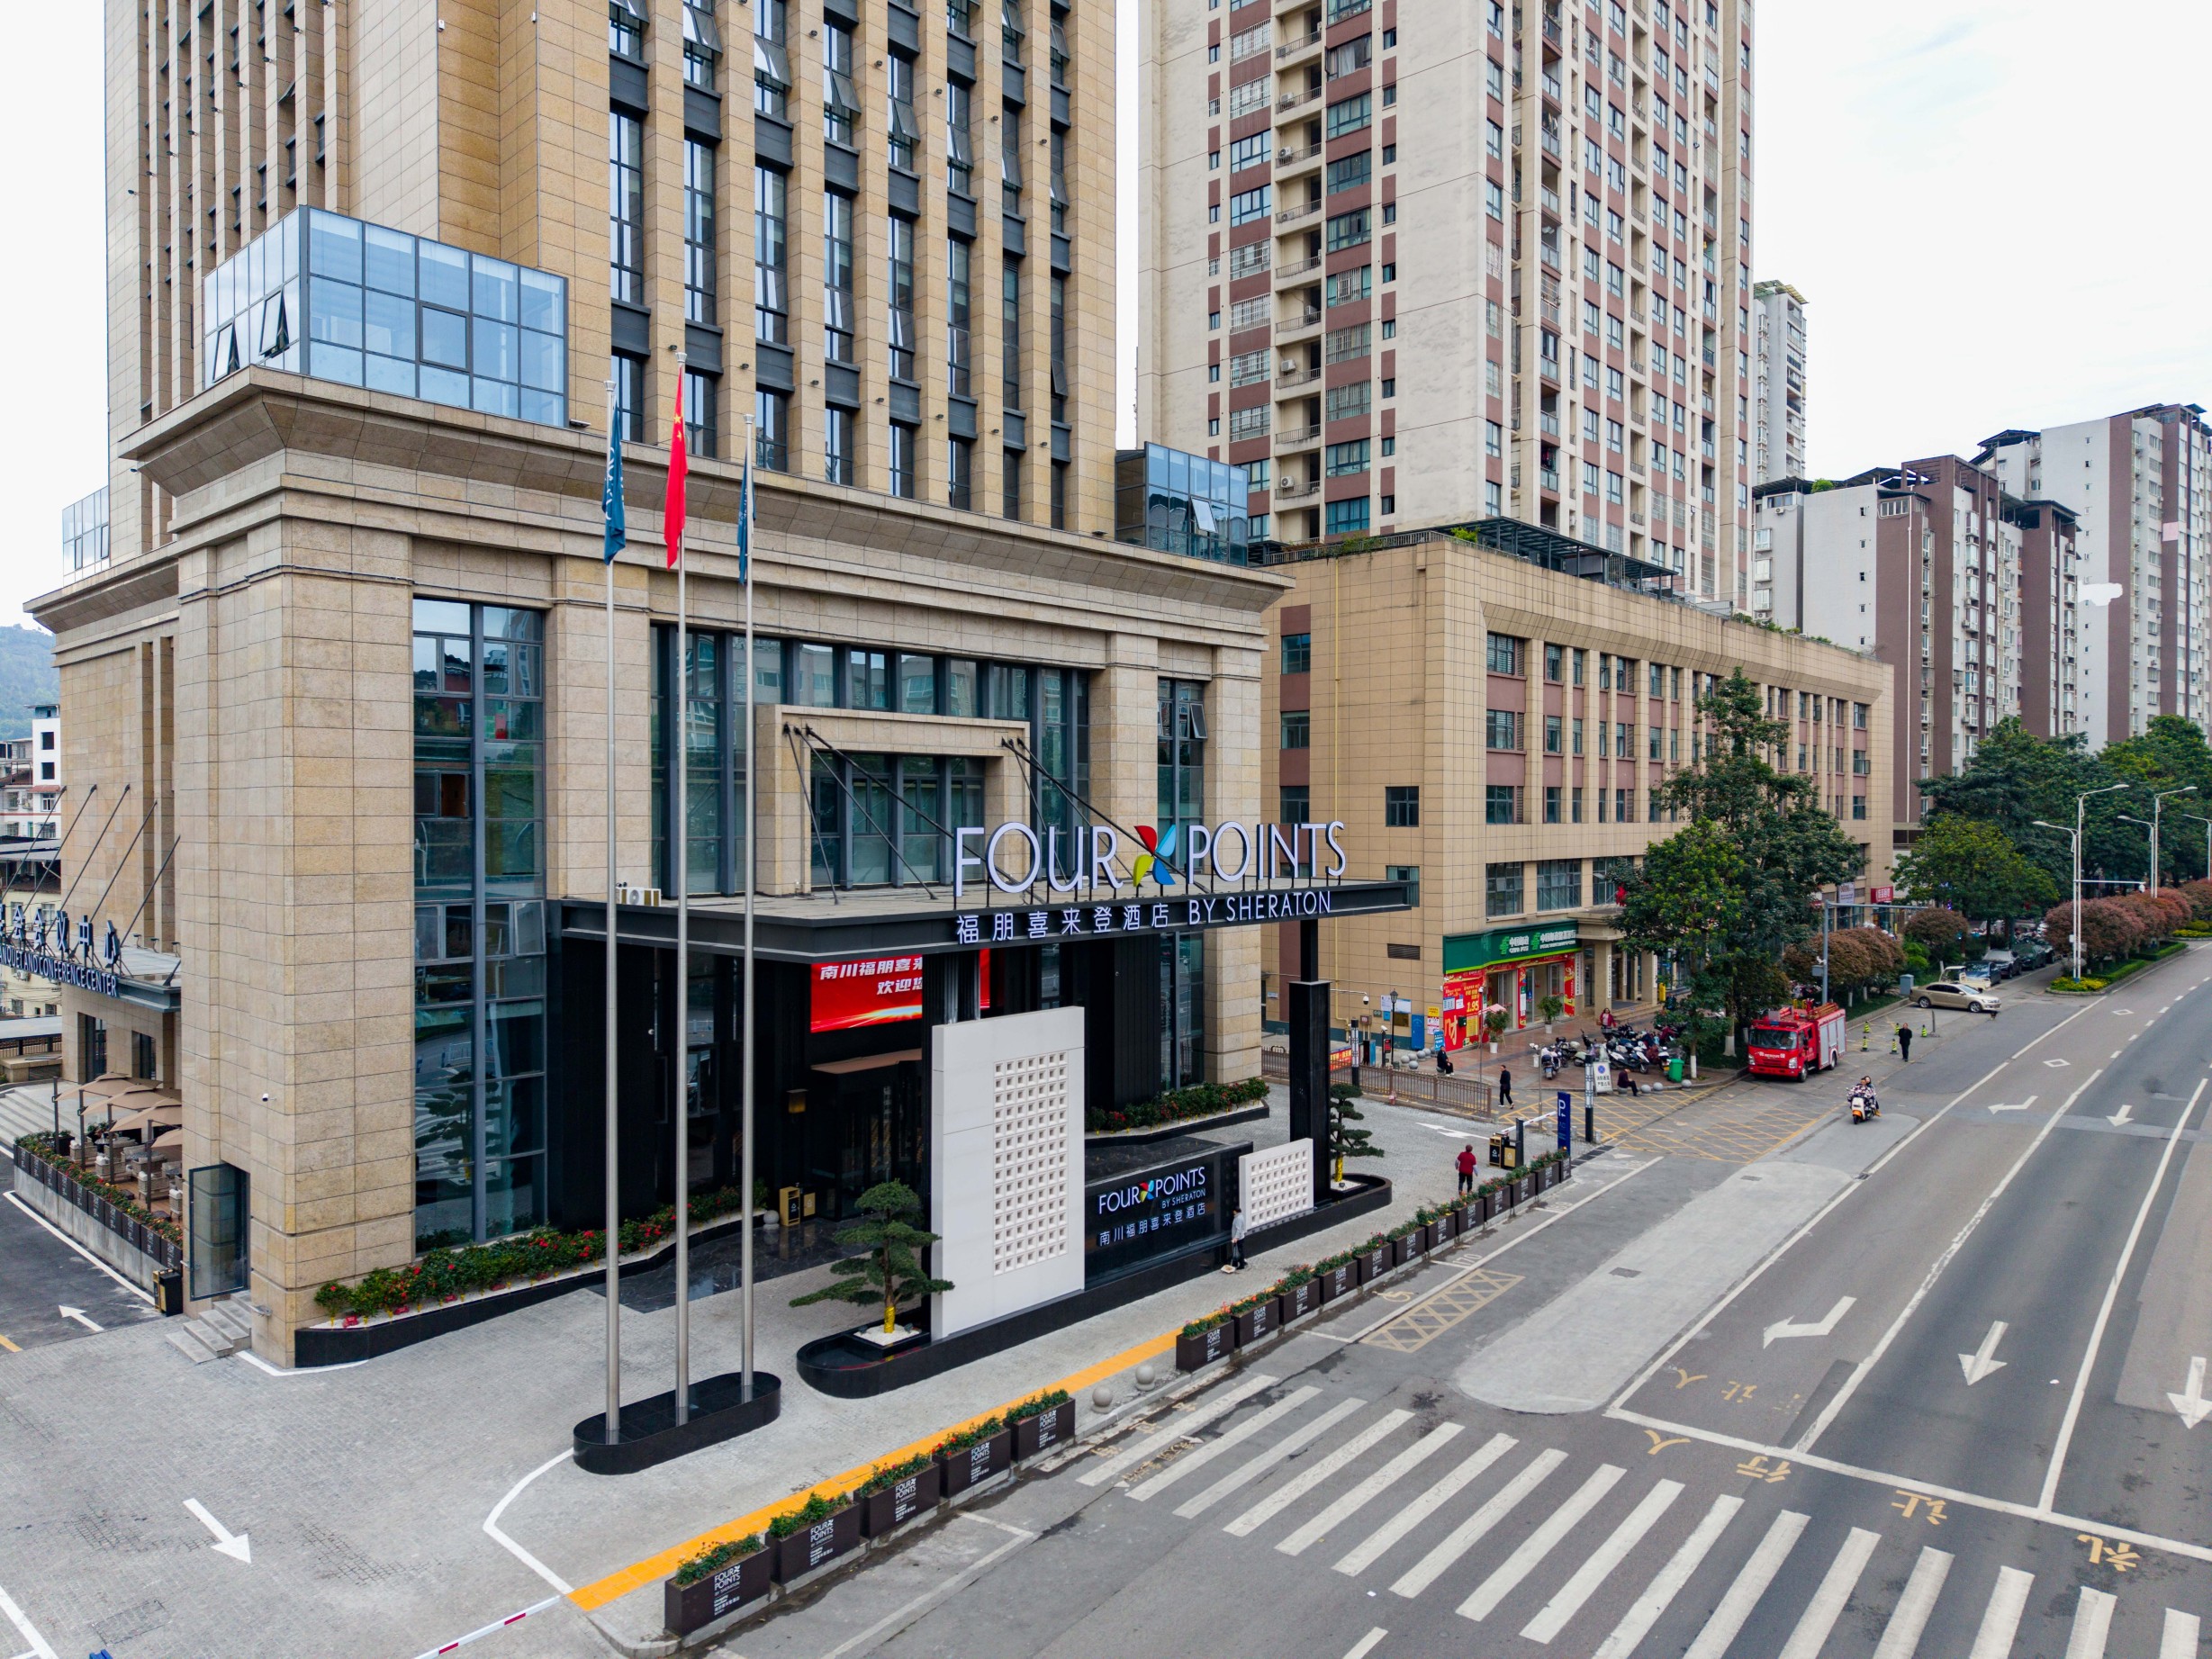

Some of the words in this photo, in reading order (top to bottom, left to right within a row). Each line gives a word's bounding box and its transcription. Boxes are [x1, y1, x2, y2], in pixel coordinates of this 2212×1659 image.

[953, 821, 1123, 897] FOUR
[1186, 821, 1346, 885] POINTS
[1188, 898, 1216, 925] BY
[1225, 890, 1331, 922] SHERATON
[956, 902, 1169, 944] 福朋喜来登酒店
[39, 956, 87, 987] CONFERENCE
[86, 968, 119, 997] CENTER
[1558, 1099, 1566, 1116] P
[1098, 1186, 1141, 1214] FOUR
[1155, 1167, 1205, 1197] POINTS
[1161, 1199, 1170, 1209] BY
[1171, 1188, 1206, 1206] SHERATON
[1099, 1203, 1205, 1246] 南川福朋喜来登酒店
[896, 1480, 911, 1492] FOUR
[896, 1485, 916, 1500] POINTS
[810, 1522, 828, 1535] FOUR
[810, 1528, 834, 1542] POINTS
[715, 1568, 734, 1582] FOUR
[715, 1574, 740, 1591] POINTS
